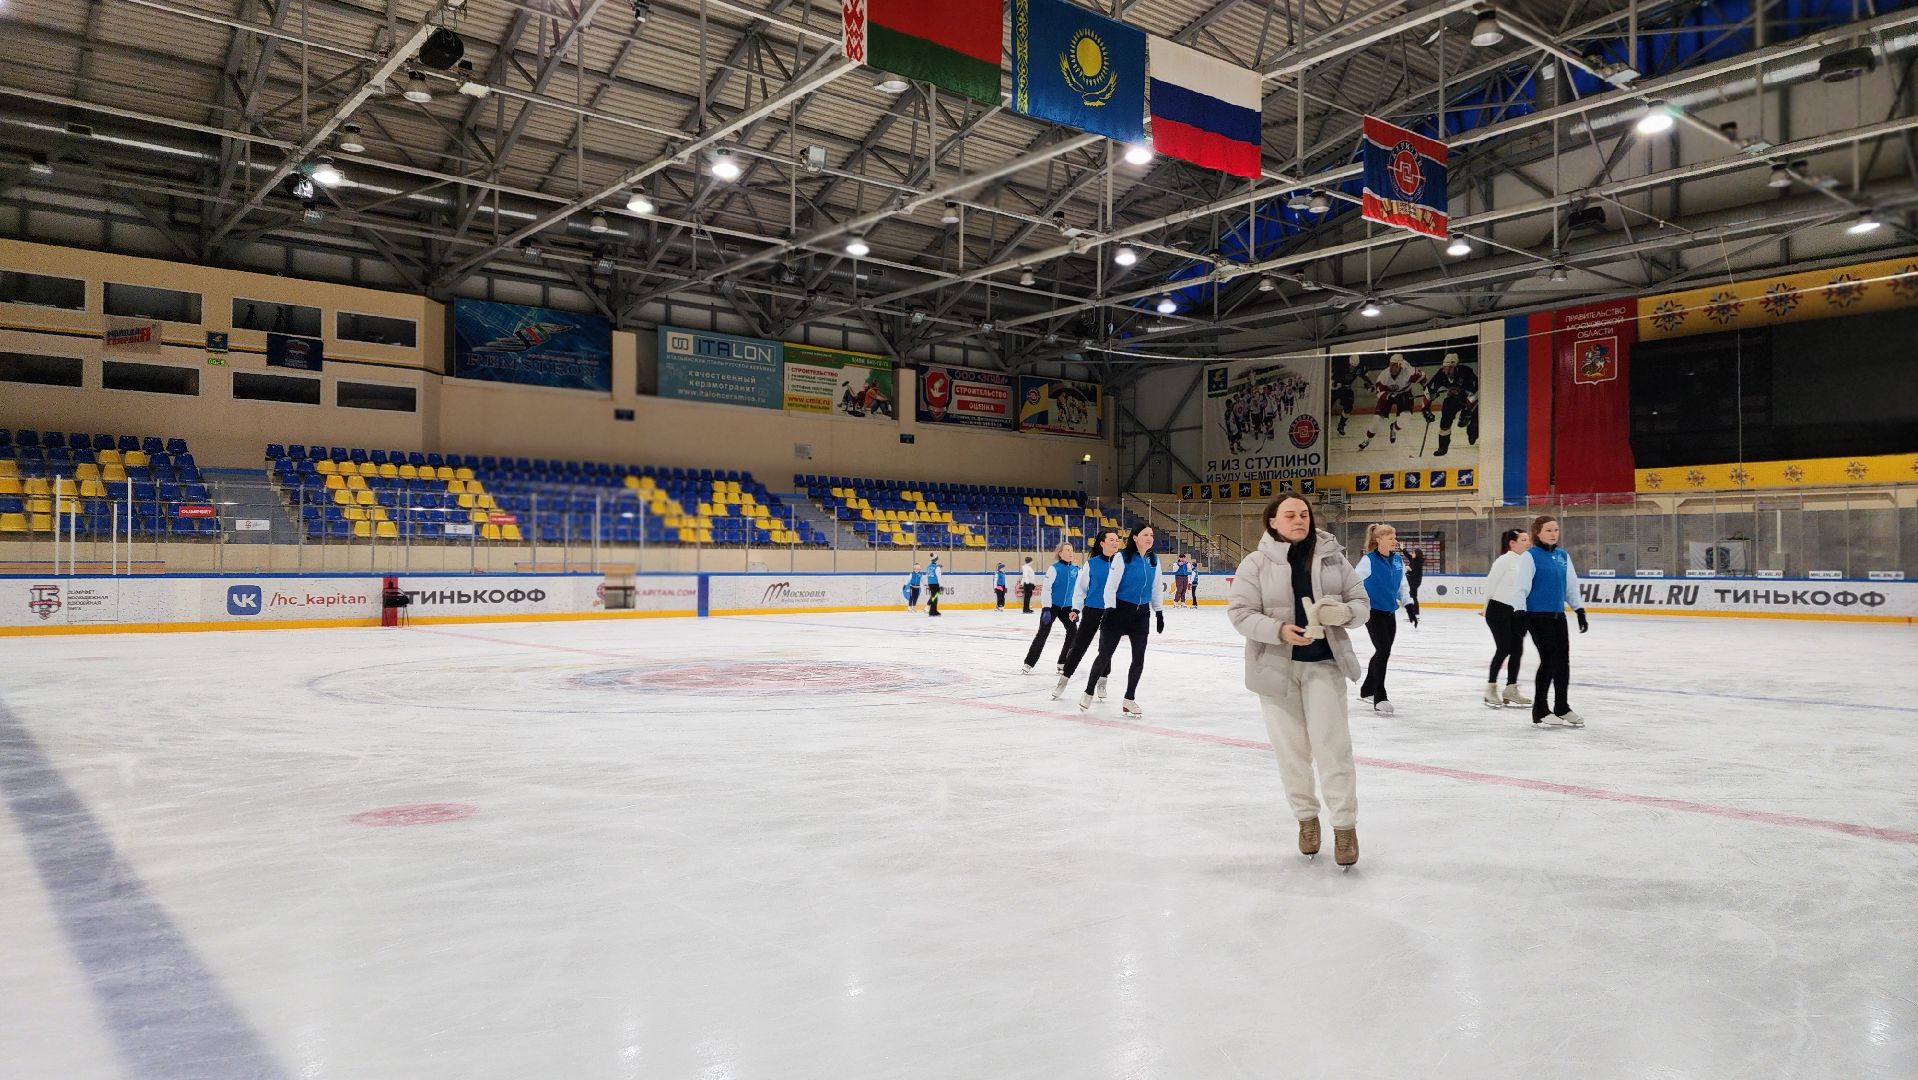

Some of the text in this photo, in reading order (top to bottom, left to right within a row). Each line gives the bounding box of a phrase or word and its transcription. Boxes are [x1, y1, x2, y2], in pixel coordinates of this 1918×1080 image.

[1565, 307, 1626, 322] ПРАВИТЕЛЬСТВО
[1577, 328, 1614, 338] ОБЛАСТИ
[698, 339, 771, 362] ITALON
[688, 370, 756, 384] качественный
[791, 367, 838, 377] СТРОИТЕЛЬСТВО
[689, 380, 755, 393] керамогранит
[955, 386, 1007, 398] СТРОИТЕЛЬСТВО
[969, 402, 994, 411] ОЦЕНКА
[1207, 453, 1320, 472] Я ИЗ СТУПИНО
[1206, 468, 1320, 483] И БУДУ ЧЕМПИОНОМ!
[404, 588, 546, 605] ТИНЬКОФФ
[1454, 586, 1485, 595] SIRIU
[1579, 583, 1700, 606] HL.KHL.RU
[1714, 588, 1886, 607] ТИНЬКОФФ
[270, 592, 367, 607] /hc_kapitan
